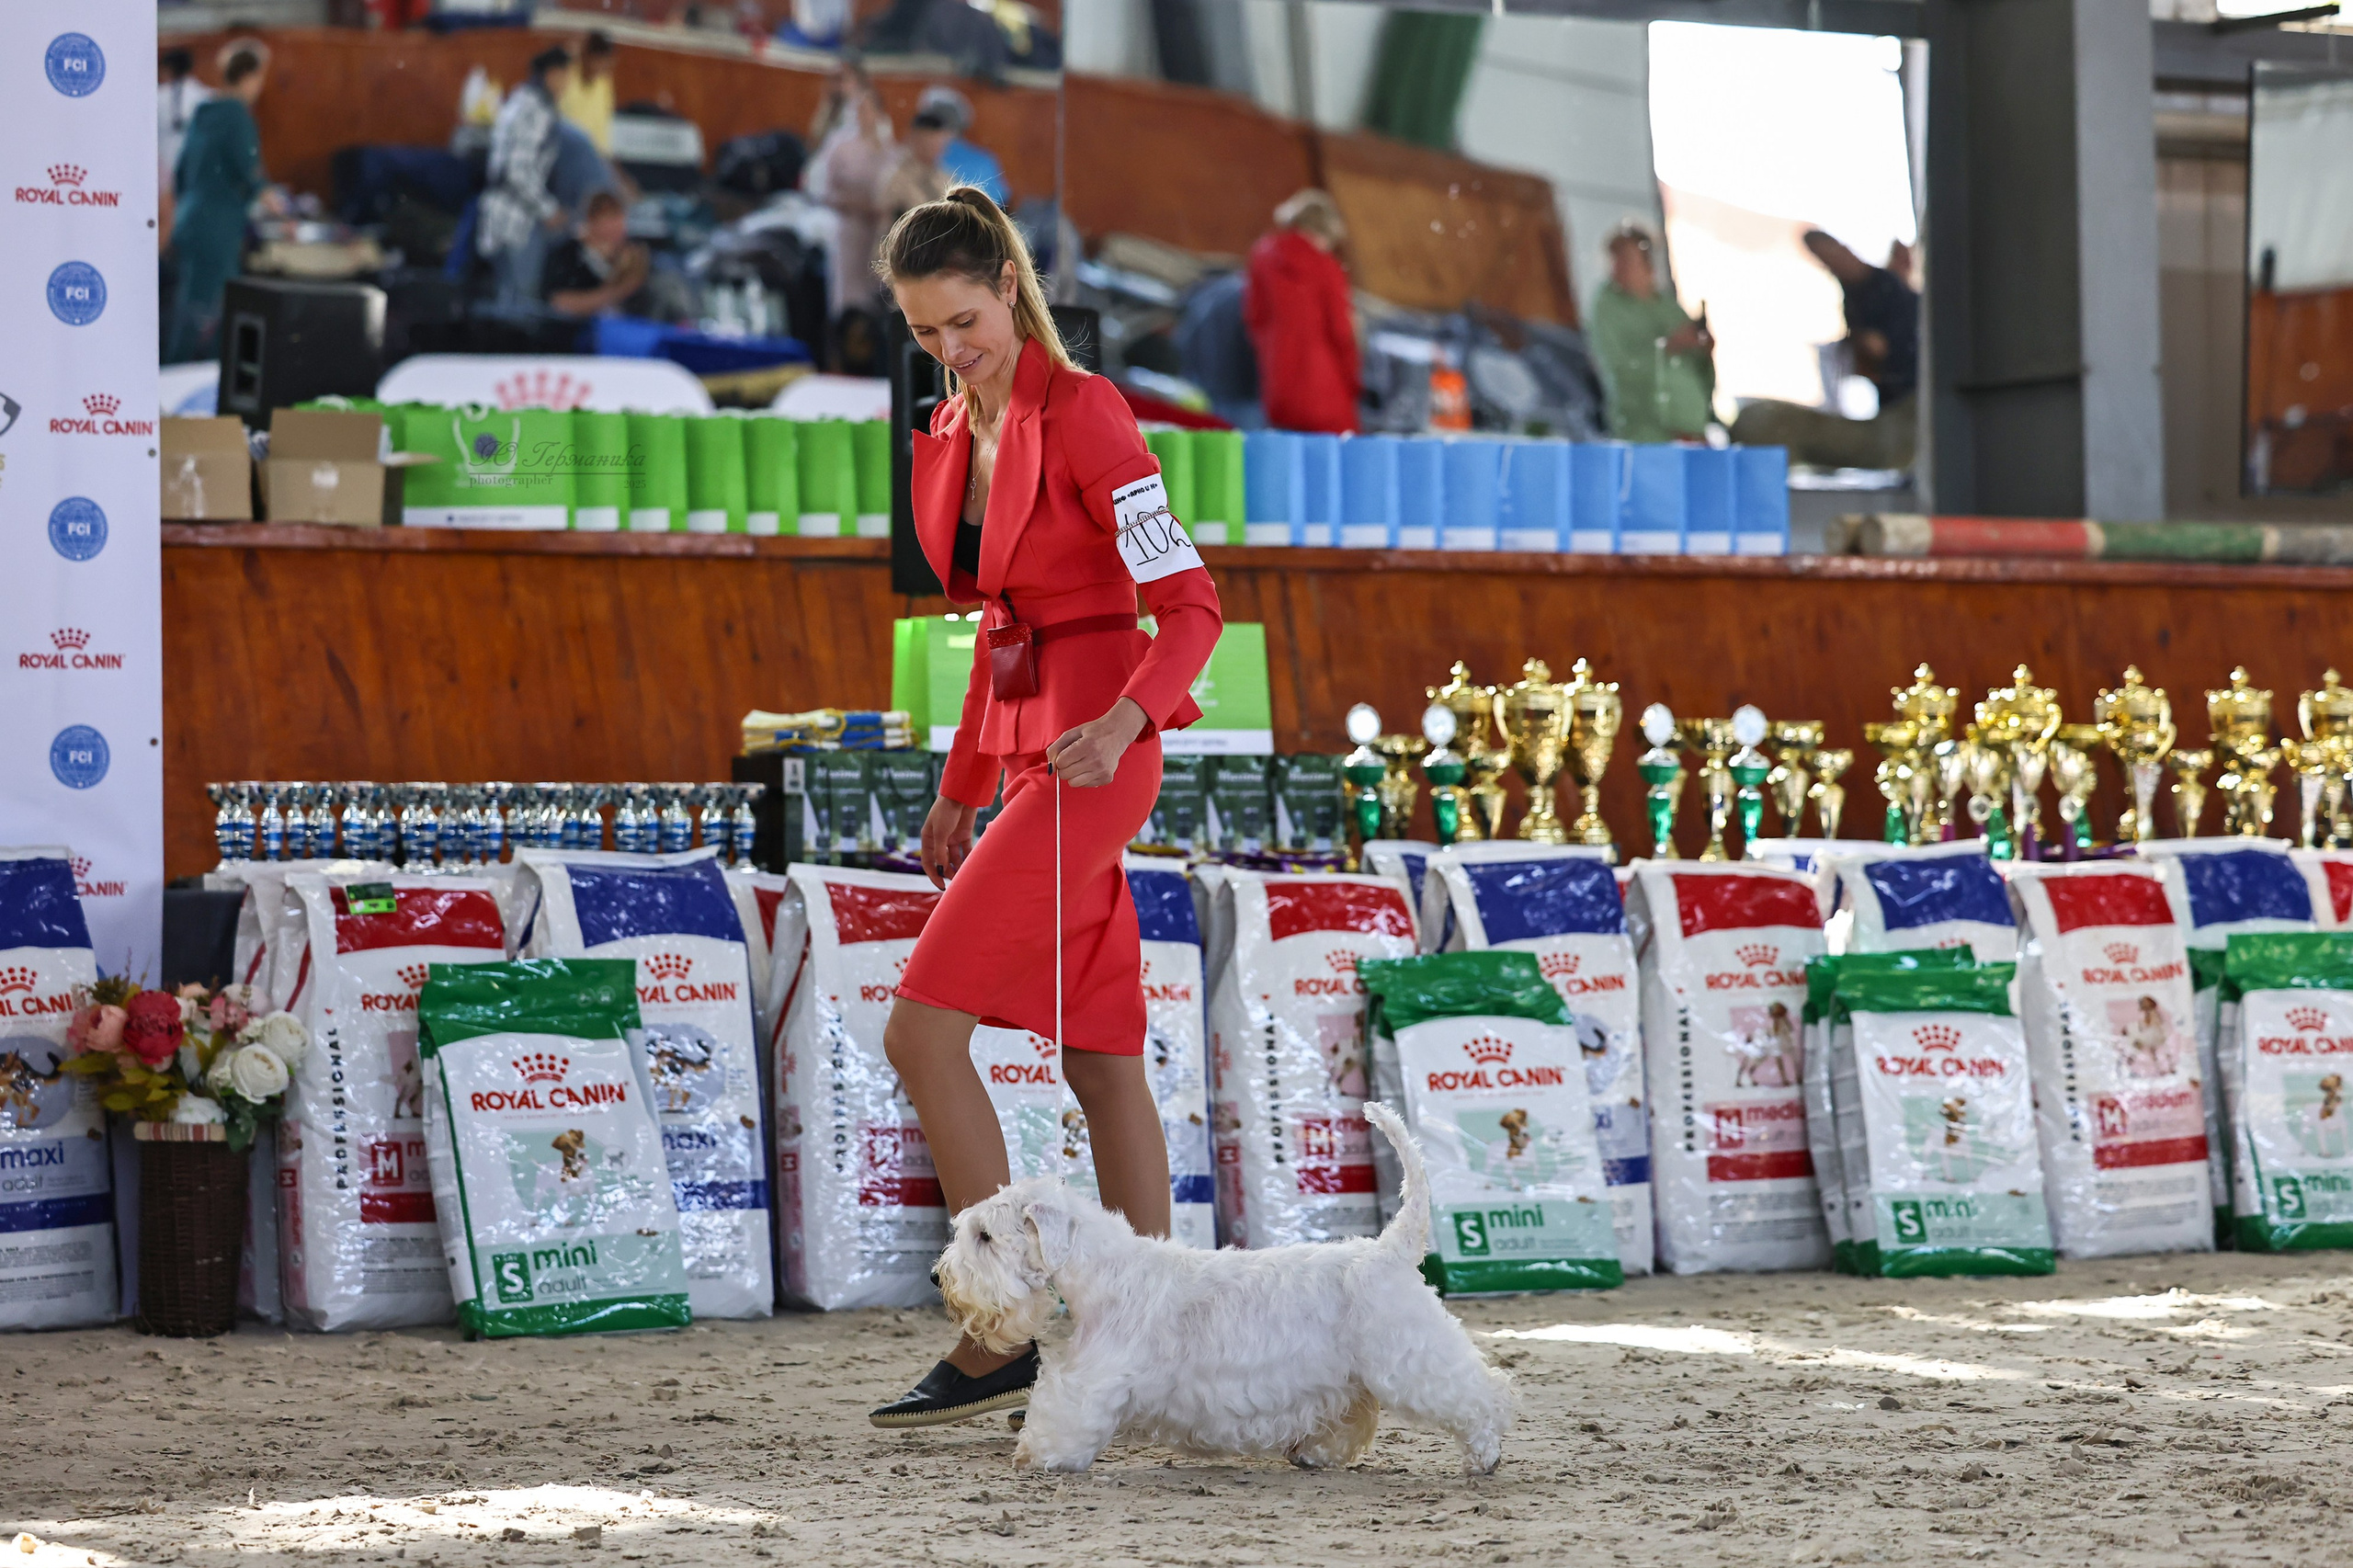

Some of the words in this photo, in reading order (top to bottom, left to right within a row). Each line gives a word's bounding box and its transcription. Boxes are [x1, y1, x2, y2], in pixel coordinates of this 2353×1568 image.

[63, 58, 87, 73] FCI
[16, 187, 64, 206] ROYAL
[68, 189, 119, 207] CANIN
[65, 286, 89, 301] FCI
[50, 418, 98, 435] ROYAL
[103, 419, 153, 436] CANIN
[67, 523, 91, 537] FCI
[19, 653, 69, 669] ROYAL
[72, 653, 123, 669] CANIN
[69, 750, 93, 765] FCI
[1705, 971, 1762, 990] ROYAL
[1765, 970, 1807, 987] CAN
[2082, 967, 2130, 985] ROYAL
[2130, 960, 2184, 983] CANIN
[636, 984, 671, 1003] YAL
[675, 983, 736, 1002] CANIN
[860, 985, 901, 1002] ROY
[1294, 978, 1349, 995] ROYAL
[1565, 973, 1627, 995] CANIN
[21, 993, 73, 1016] CANI
[2258, 1037, 2313, 1055] ROYAL
[990, 1064, 1056, 1084] ROYAL
[1876, 1056, 1937, 1076] ROYAL
[1941, 1057, 2005, 1077] CANIN
[1427, 1070, 1495, 1092] ROYAL
[1497, 1066, 1564, 1086] CANIN
[471, 1089, 545, 1111] ROYAL
[550, 1083, 627, 1108] CANIN
[0, 1141, 64, 1169] maxi
[377, 1151, 400, 1179] M
[2279, 1182, 2301, 1211] S
[1488, 1204, 1544, 1228] mini
[1898, 1208, 1920, 1235] S
[1459, 1219, 1483, 1249] S
[533, 1240, 598, 1270] mini
[501, 1261, 525, 1294] S
[538, 1275, 588, 1294] adult
